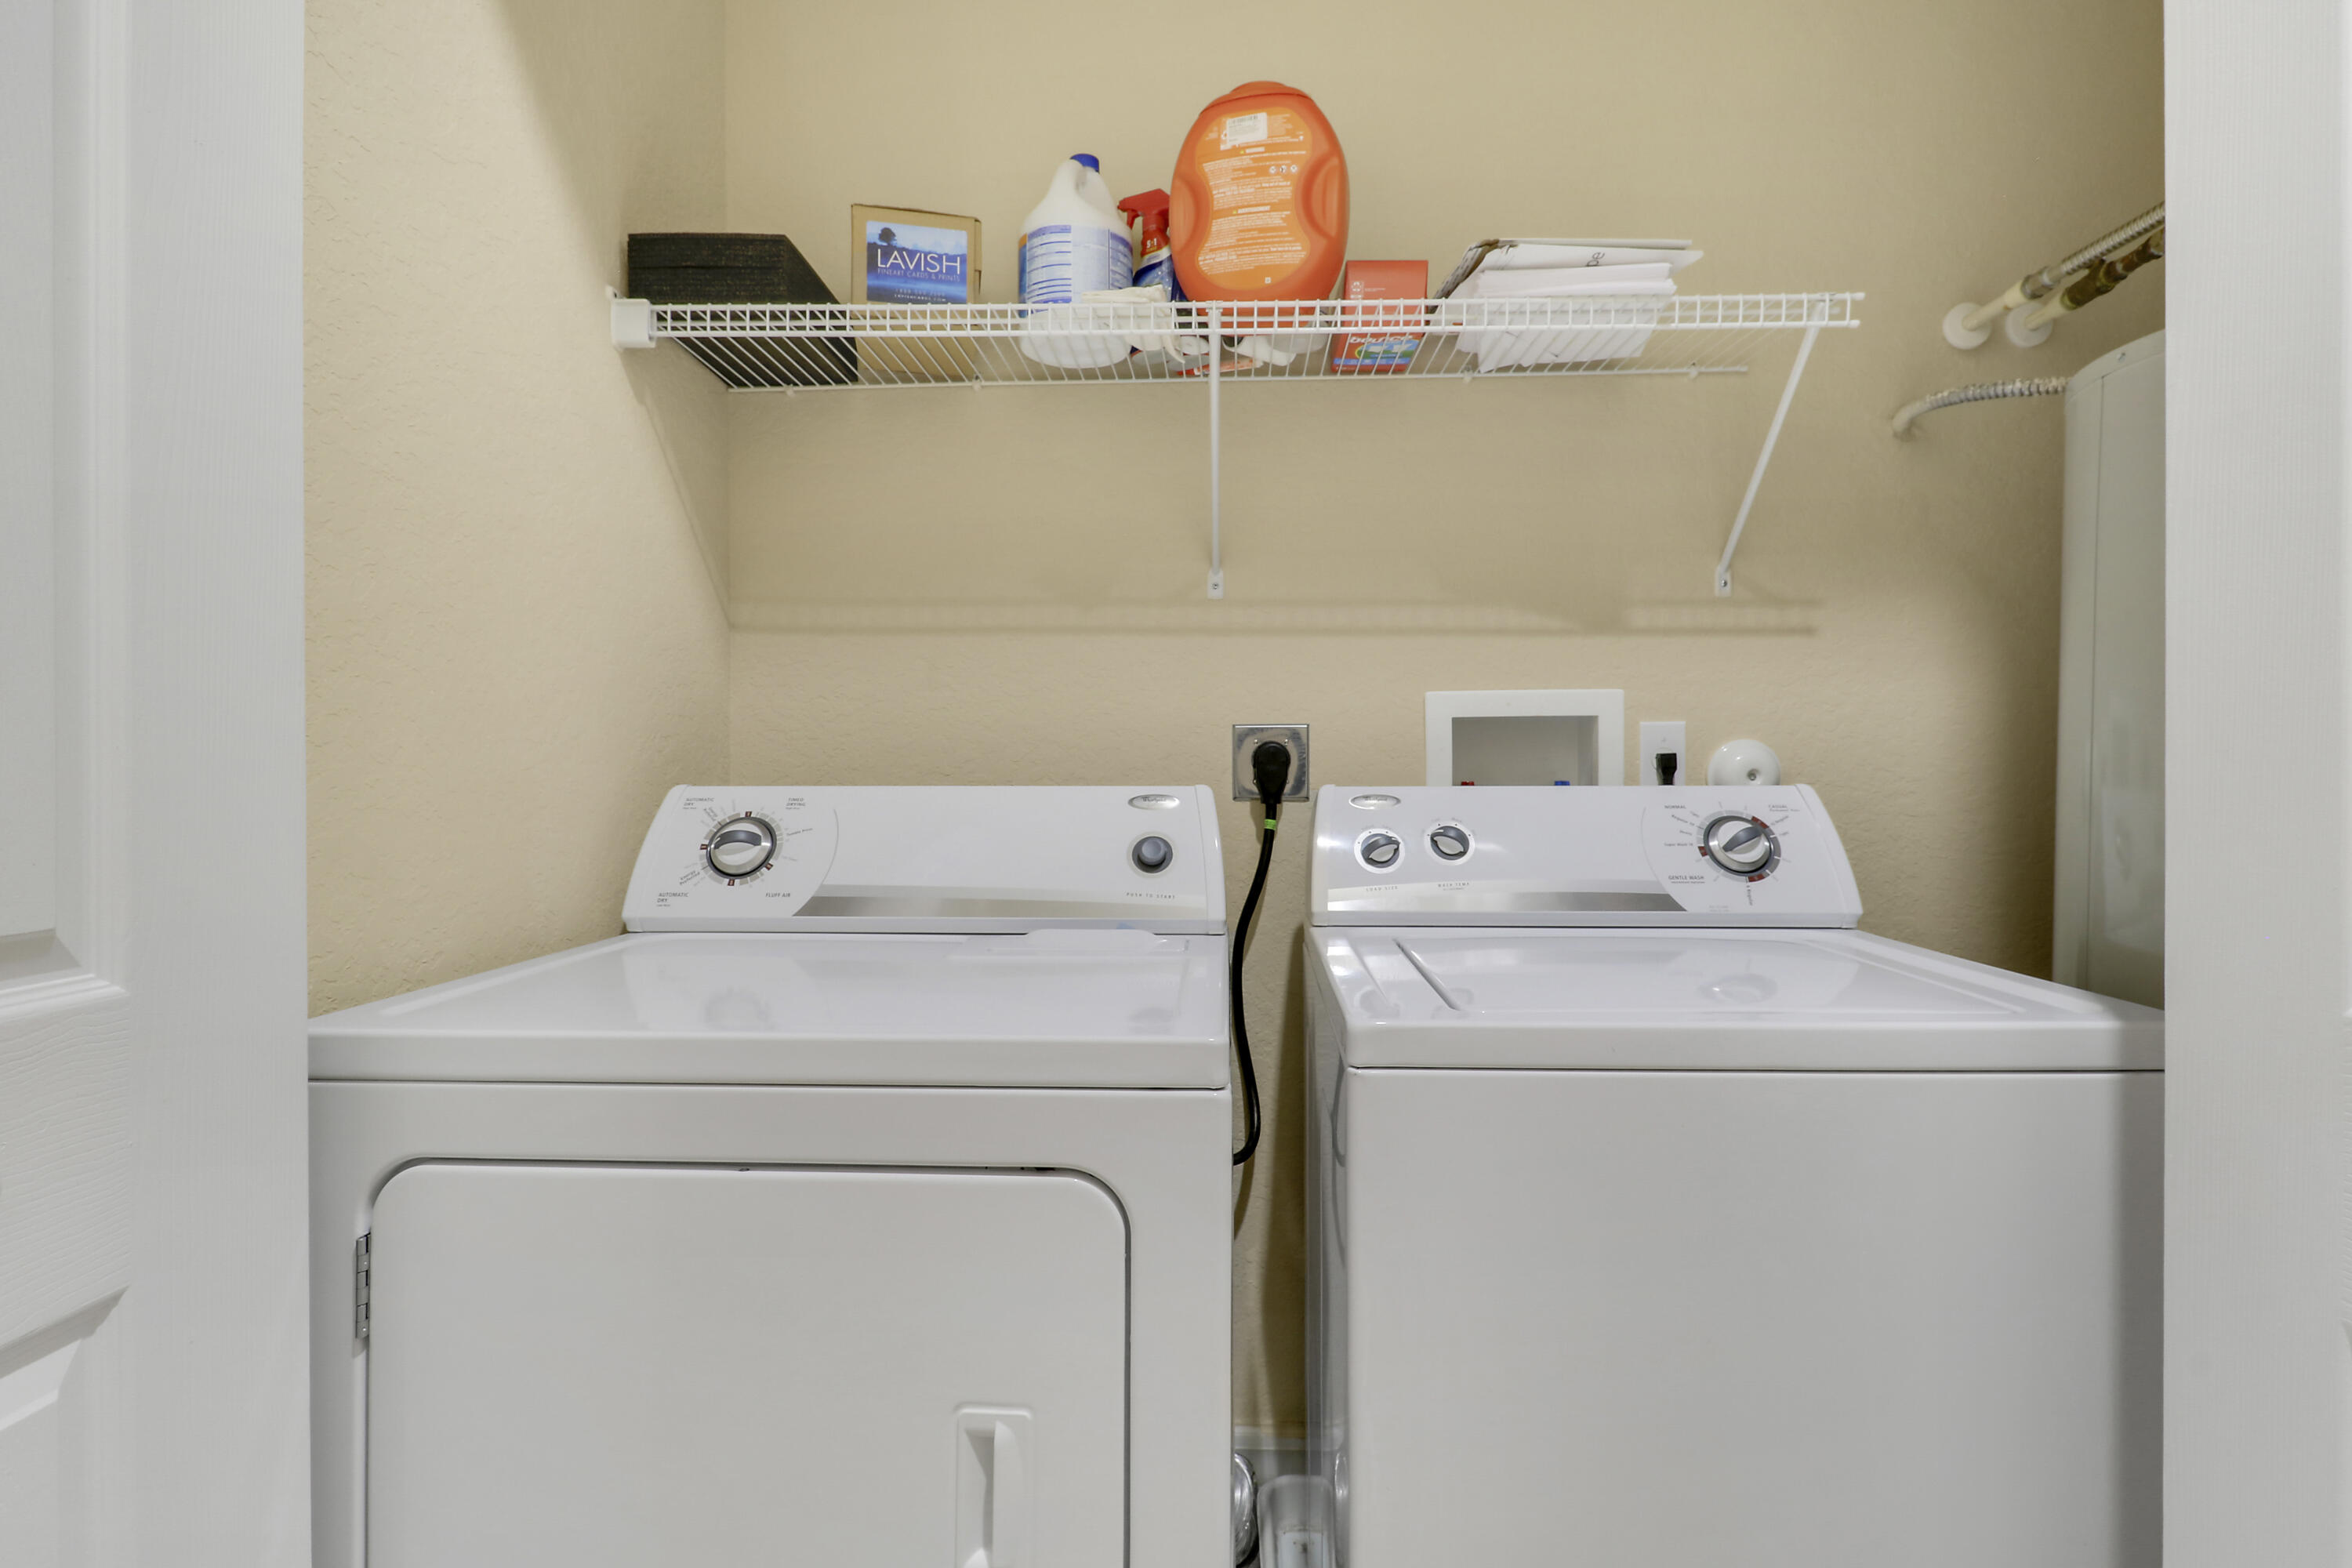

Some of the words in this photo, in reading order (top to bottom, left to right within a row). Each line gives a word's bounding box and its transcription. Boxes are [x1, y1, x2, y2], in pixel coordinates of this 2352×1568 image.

[877, 249, 960, 274] LAVISH
[906, 270, 928, 279] CARDS
[938, 273, 960, 282] PRINTS
